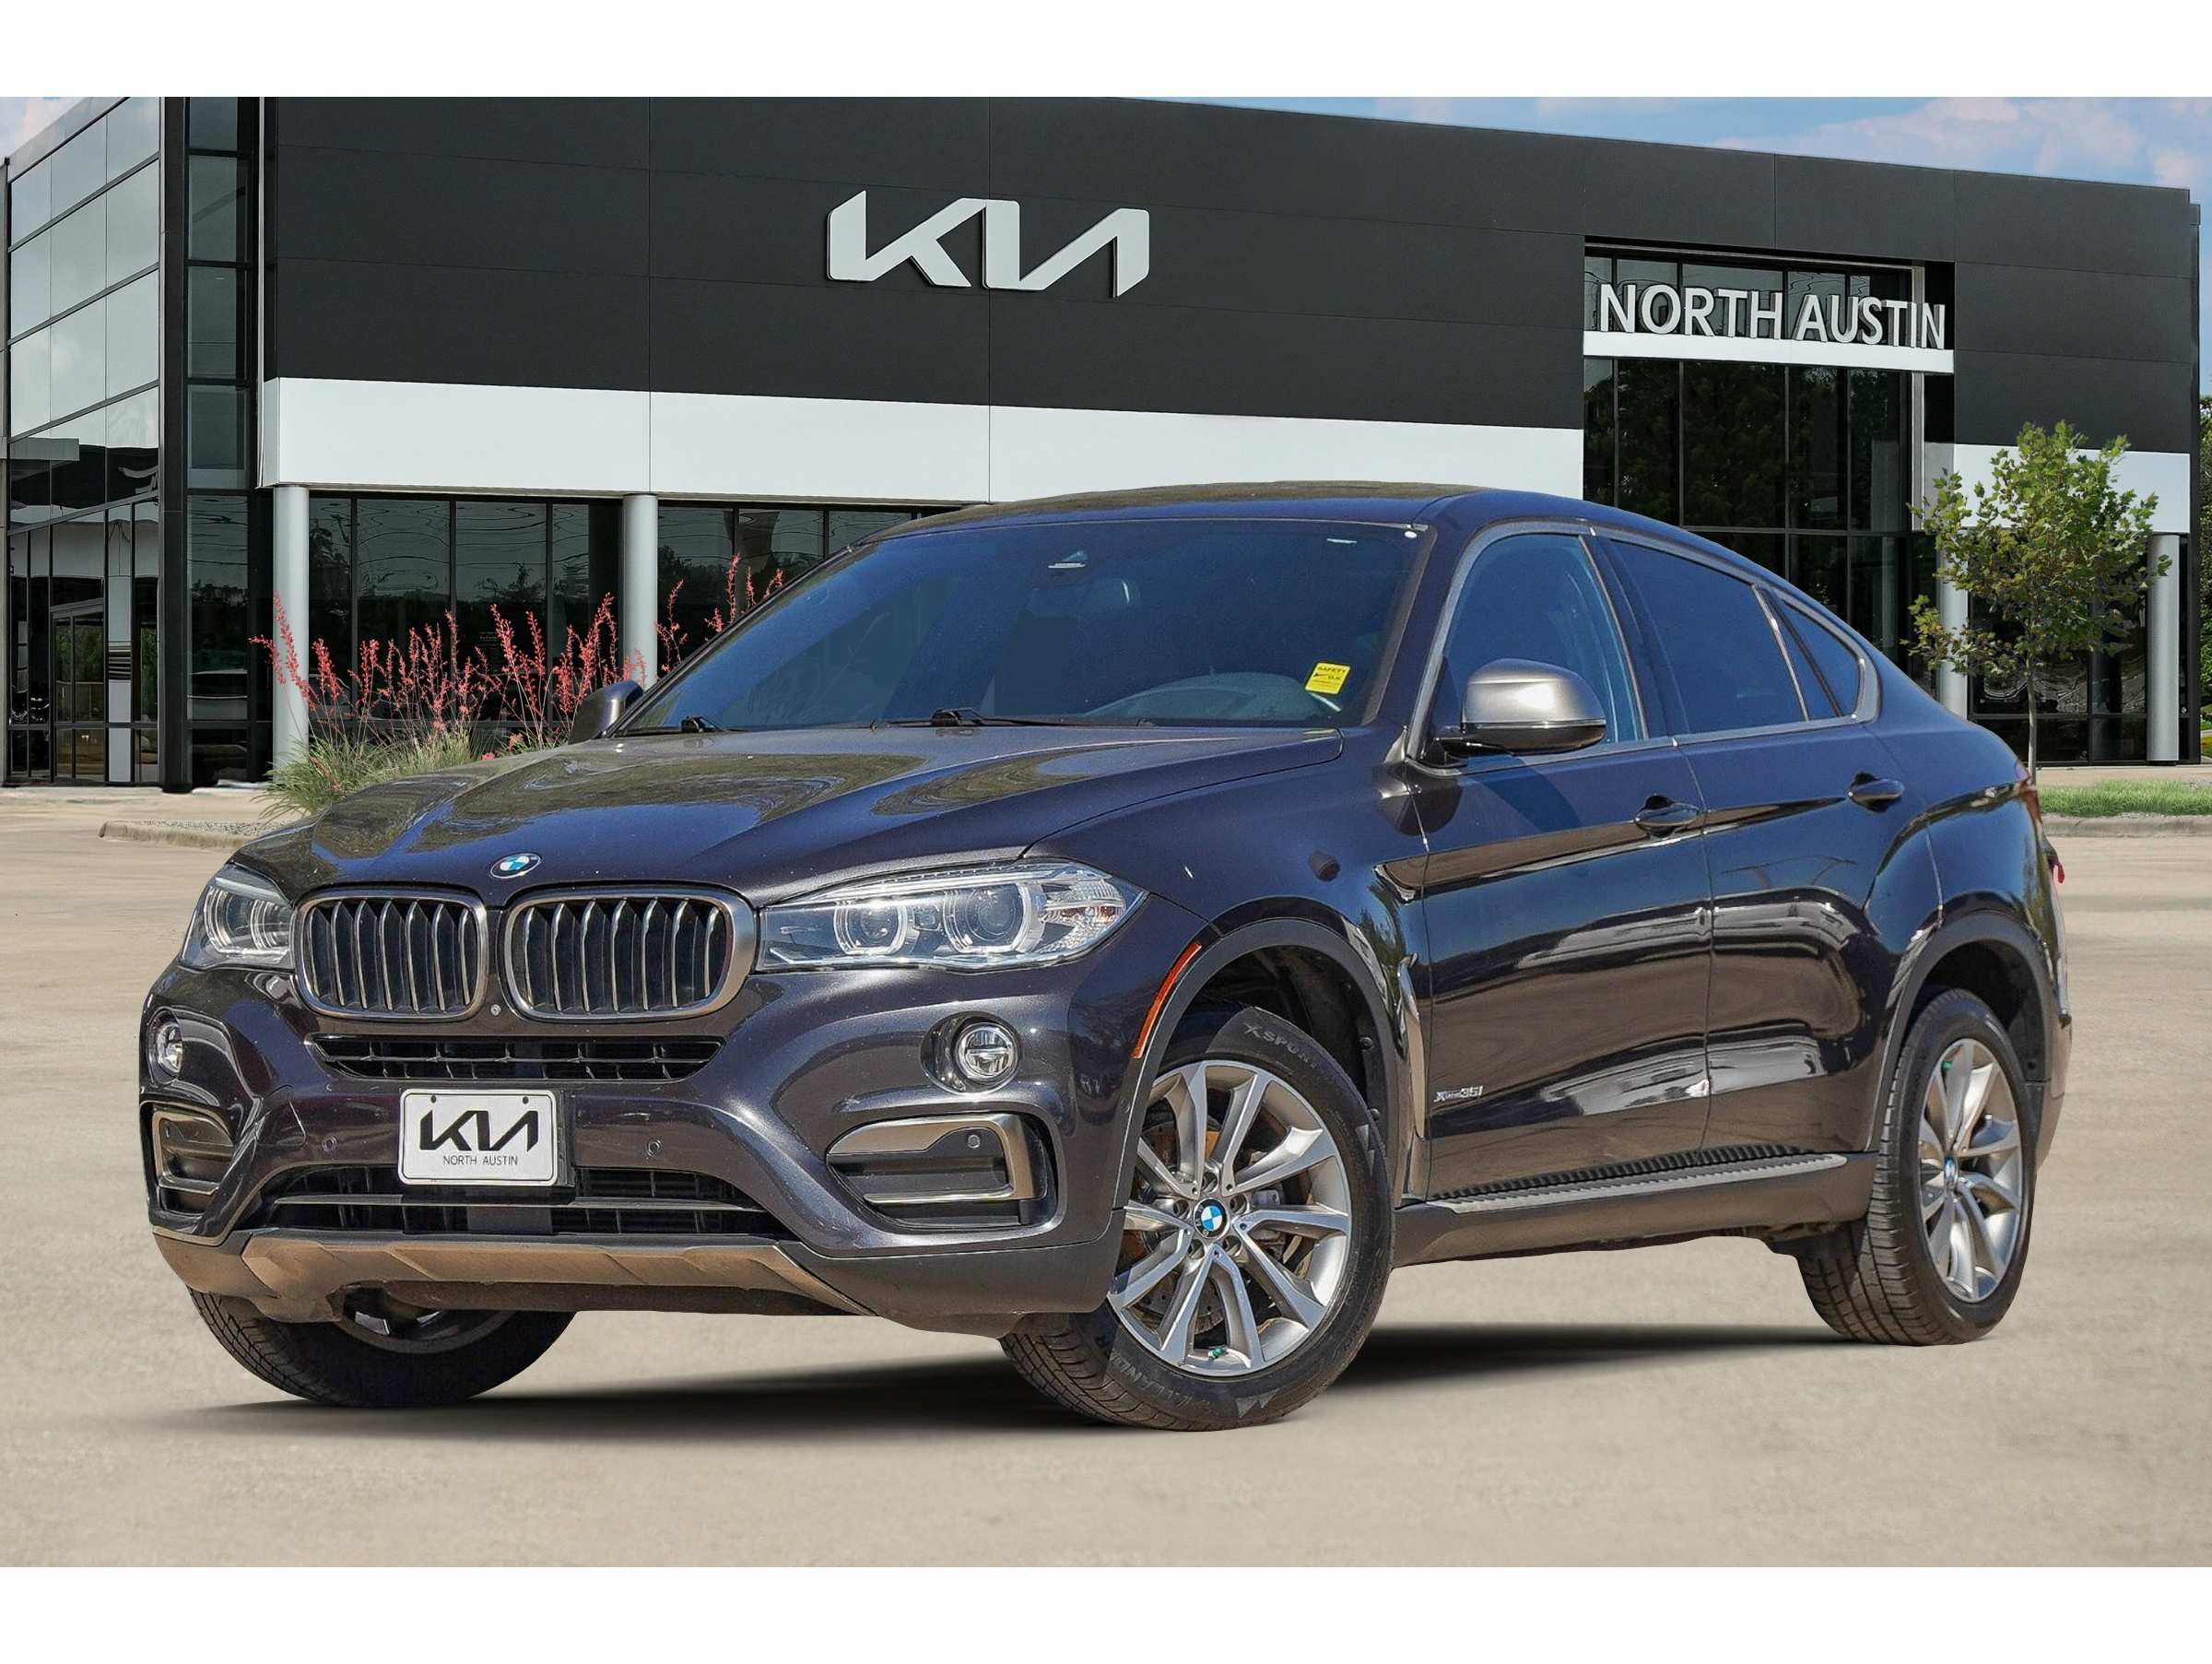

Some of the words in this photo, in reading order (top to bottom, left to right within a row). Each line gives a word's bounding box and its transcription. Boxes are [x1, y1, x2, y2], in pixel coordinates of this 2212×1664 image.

[827, 190, 1150, 298] KIA
[1599, 283, 1783, 339] NORTH
[1795, 293, 1946, 349] AUSTIN
[419, 1110, 539, 1152] KIA
[443, 1155, 477, 1166] NORTH
[483, 1155, 518, 1166] AUSTIN
